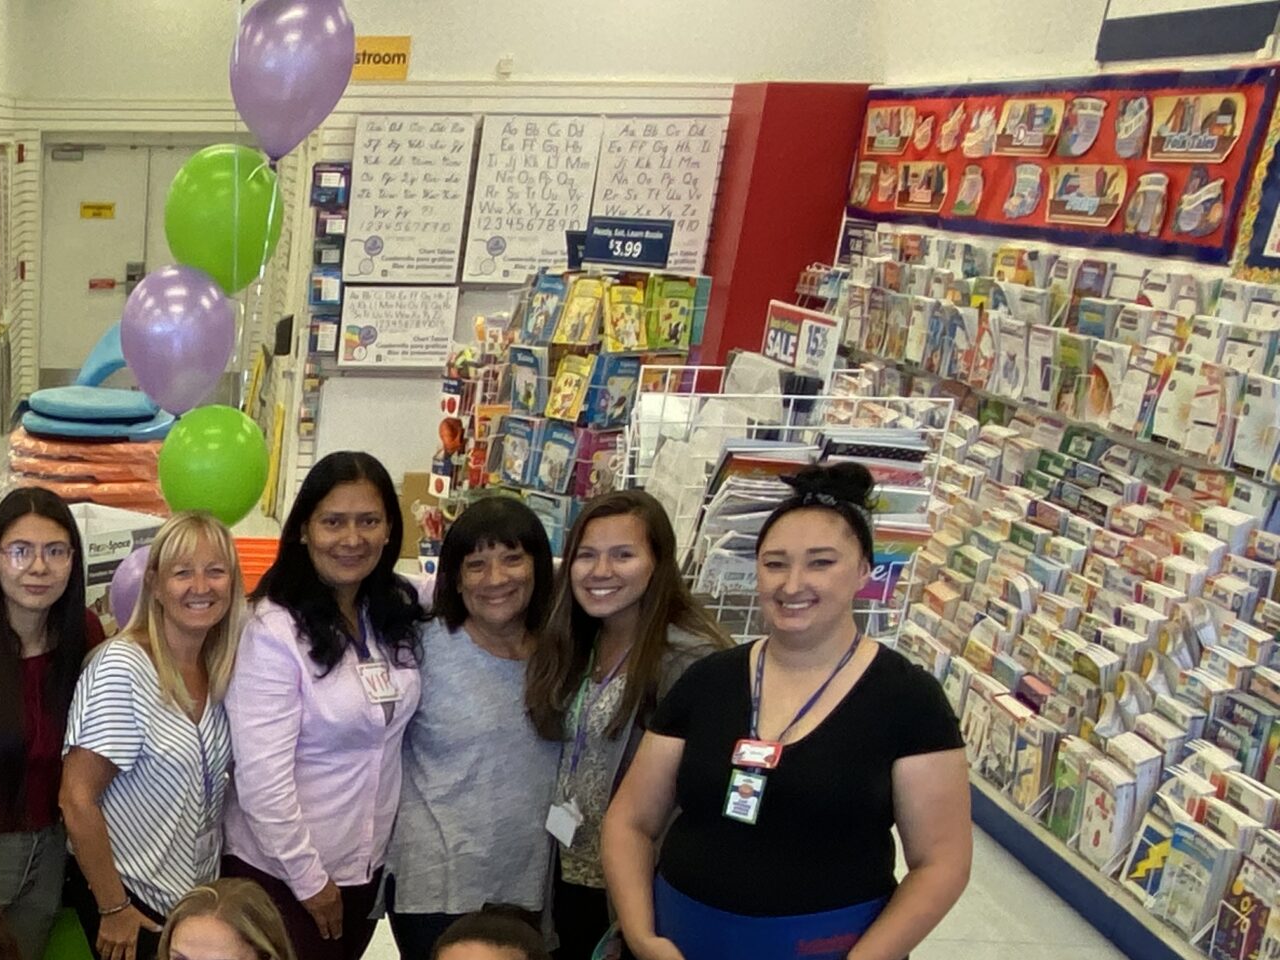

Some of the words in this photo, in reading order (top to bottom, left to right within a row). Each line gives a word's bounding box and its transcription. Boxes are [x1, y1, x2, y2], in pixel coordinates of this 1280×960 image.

[354, 49, 407, 66] stroom
[1188, 132, 1218, 151] Tales
[608, 239, 642, 258] $3.99
[765, 328, 797, 364] SALE
[365, 671, 389, 692] VIP
